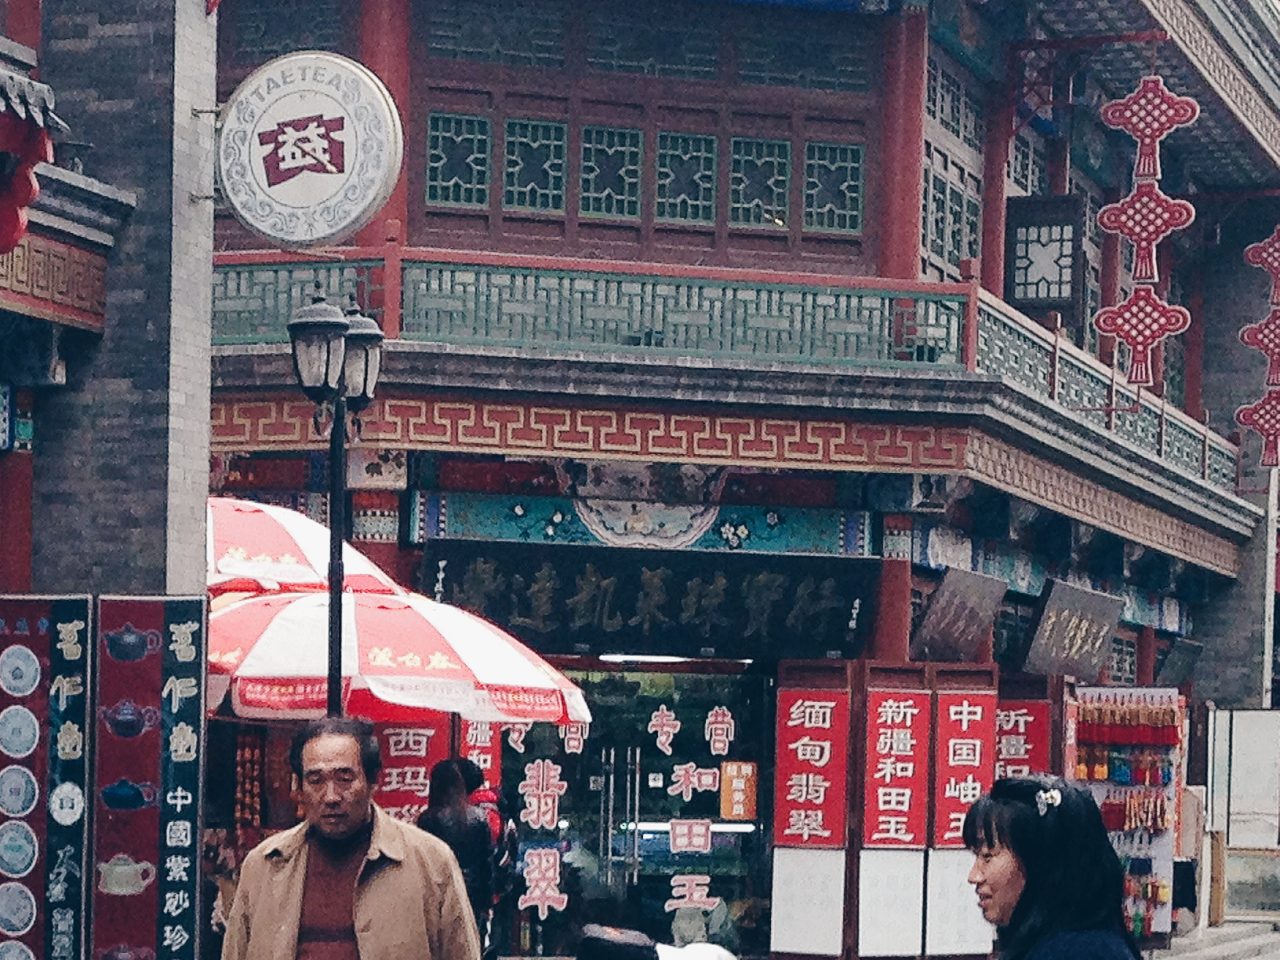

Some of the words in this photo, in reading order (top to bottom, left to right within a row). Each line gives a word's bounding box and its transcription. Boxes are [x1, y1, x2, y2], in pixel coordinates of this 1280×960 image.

[250, 65, 342, 105] TAETEA
[647, 703, 736, 756] 专营
[783, 699, 837, 842] 缅甸翡翠
[871, 698, 920, 843] 新疆和田玉
[517, 758, 569, 921] 翡翠
[663, 760, 721, 912] 和田玉
